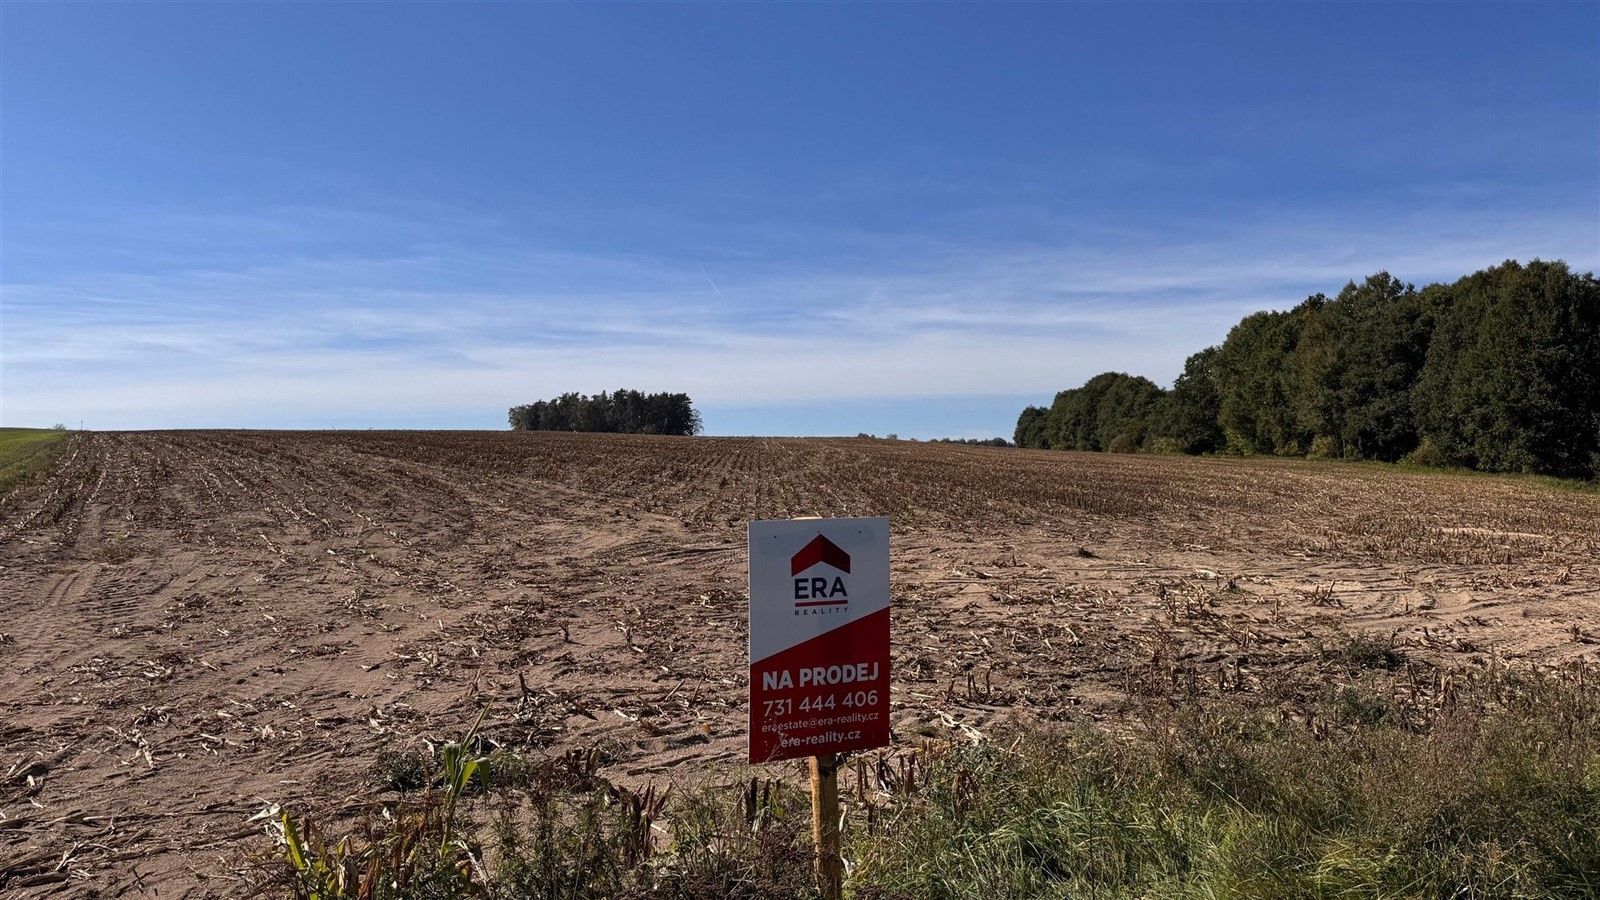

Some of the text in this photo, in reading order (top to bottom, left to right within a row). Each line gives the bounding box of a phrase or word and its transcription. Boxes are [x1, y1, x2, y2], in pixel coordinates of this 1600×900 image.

[795, 577, 848, 600] ERA
[794, 607, 849, 616] REALITY
[762, 662, 879, 691] NA PRODEJ
[763, 690, 878, 717] 731 444 406
[780, 730, 861, 748] era-reality.cz
